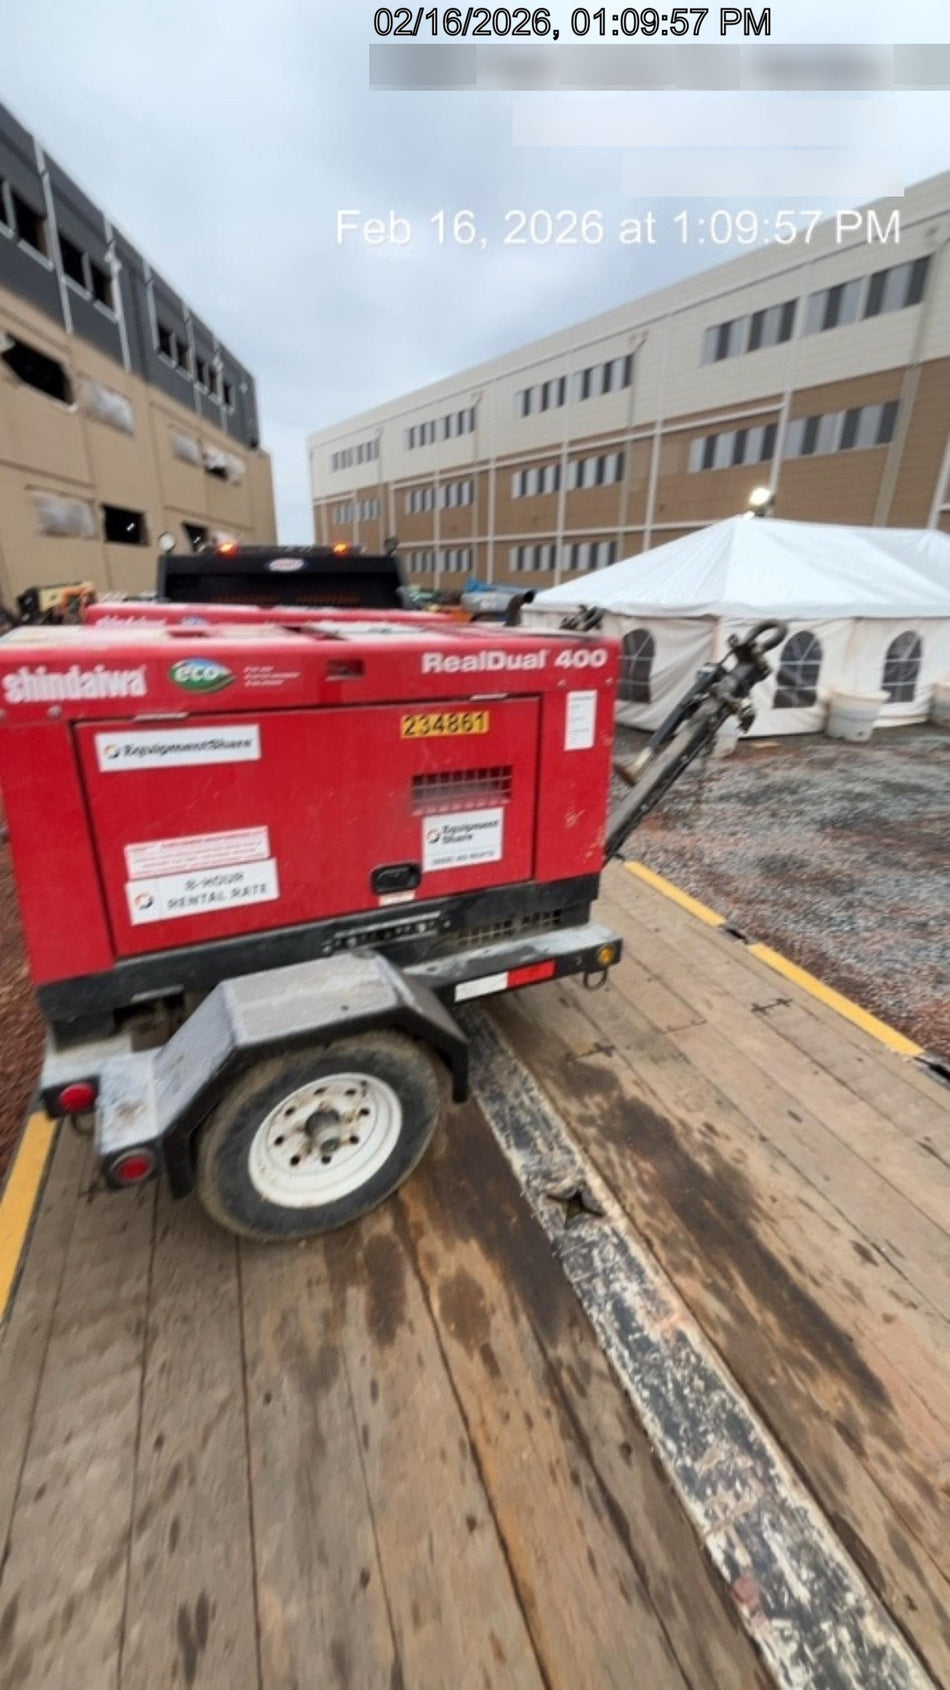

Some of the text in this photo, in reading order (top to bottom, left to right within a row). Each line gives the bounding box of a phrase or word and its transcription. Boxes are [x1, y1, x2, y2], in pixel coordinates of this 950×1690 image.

[421, 649, 608, 673] RealDual 400
[2, 665, 147, 703] shindaiwa
[173, 665, 216, 682] eco
[403, 712, 486, 736] 234861
[230, 883, 269, 899] RATE
